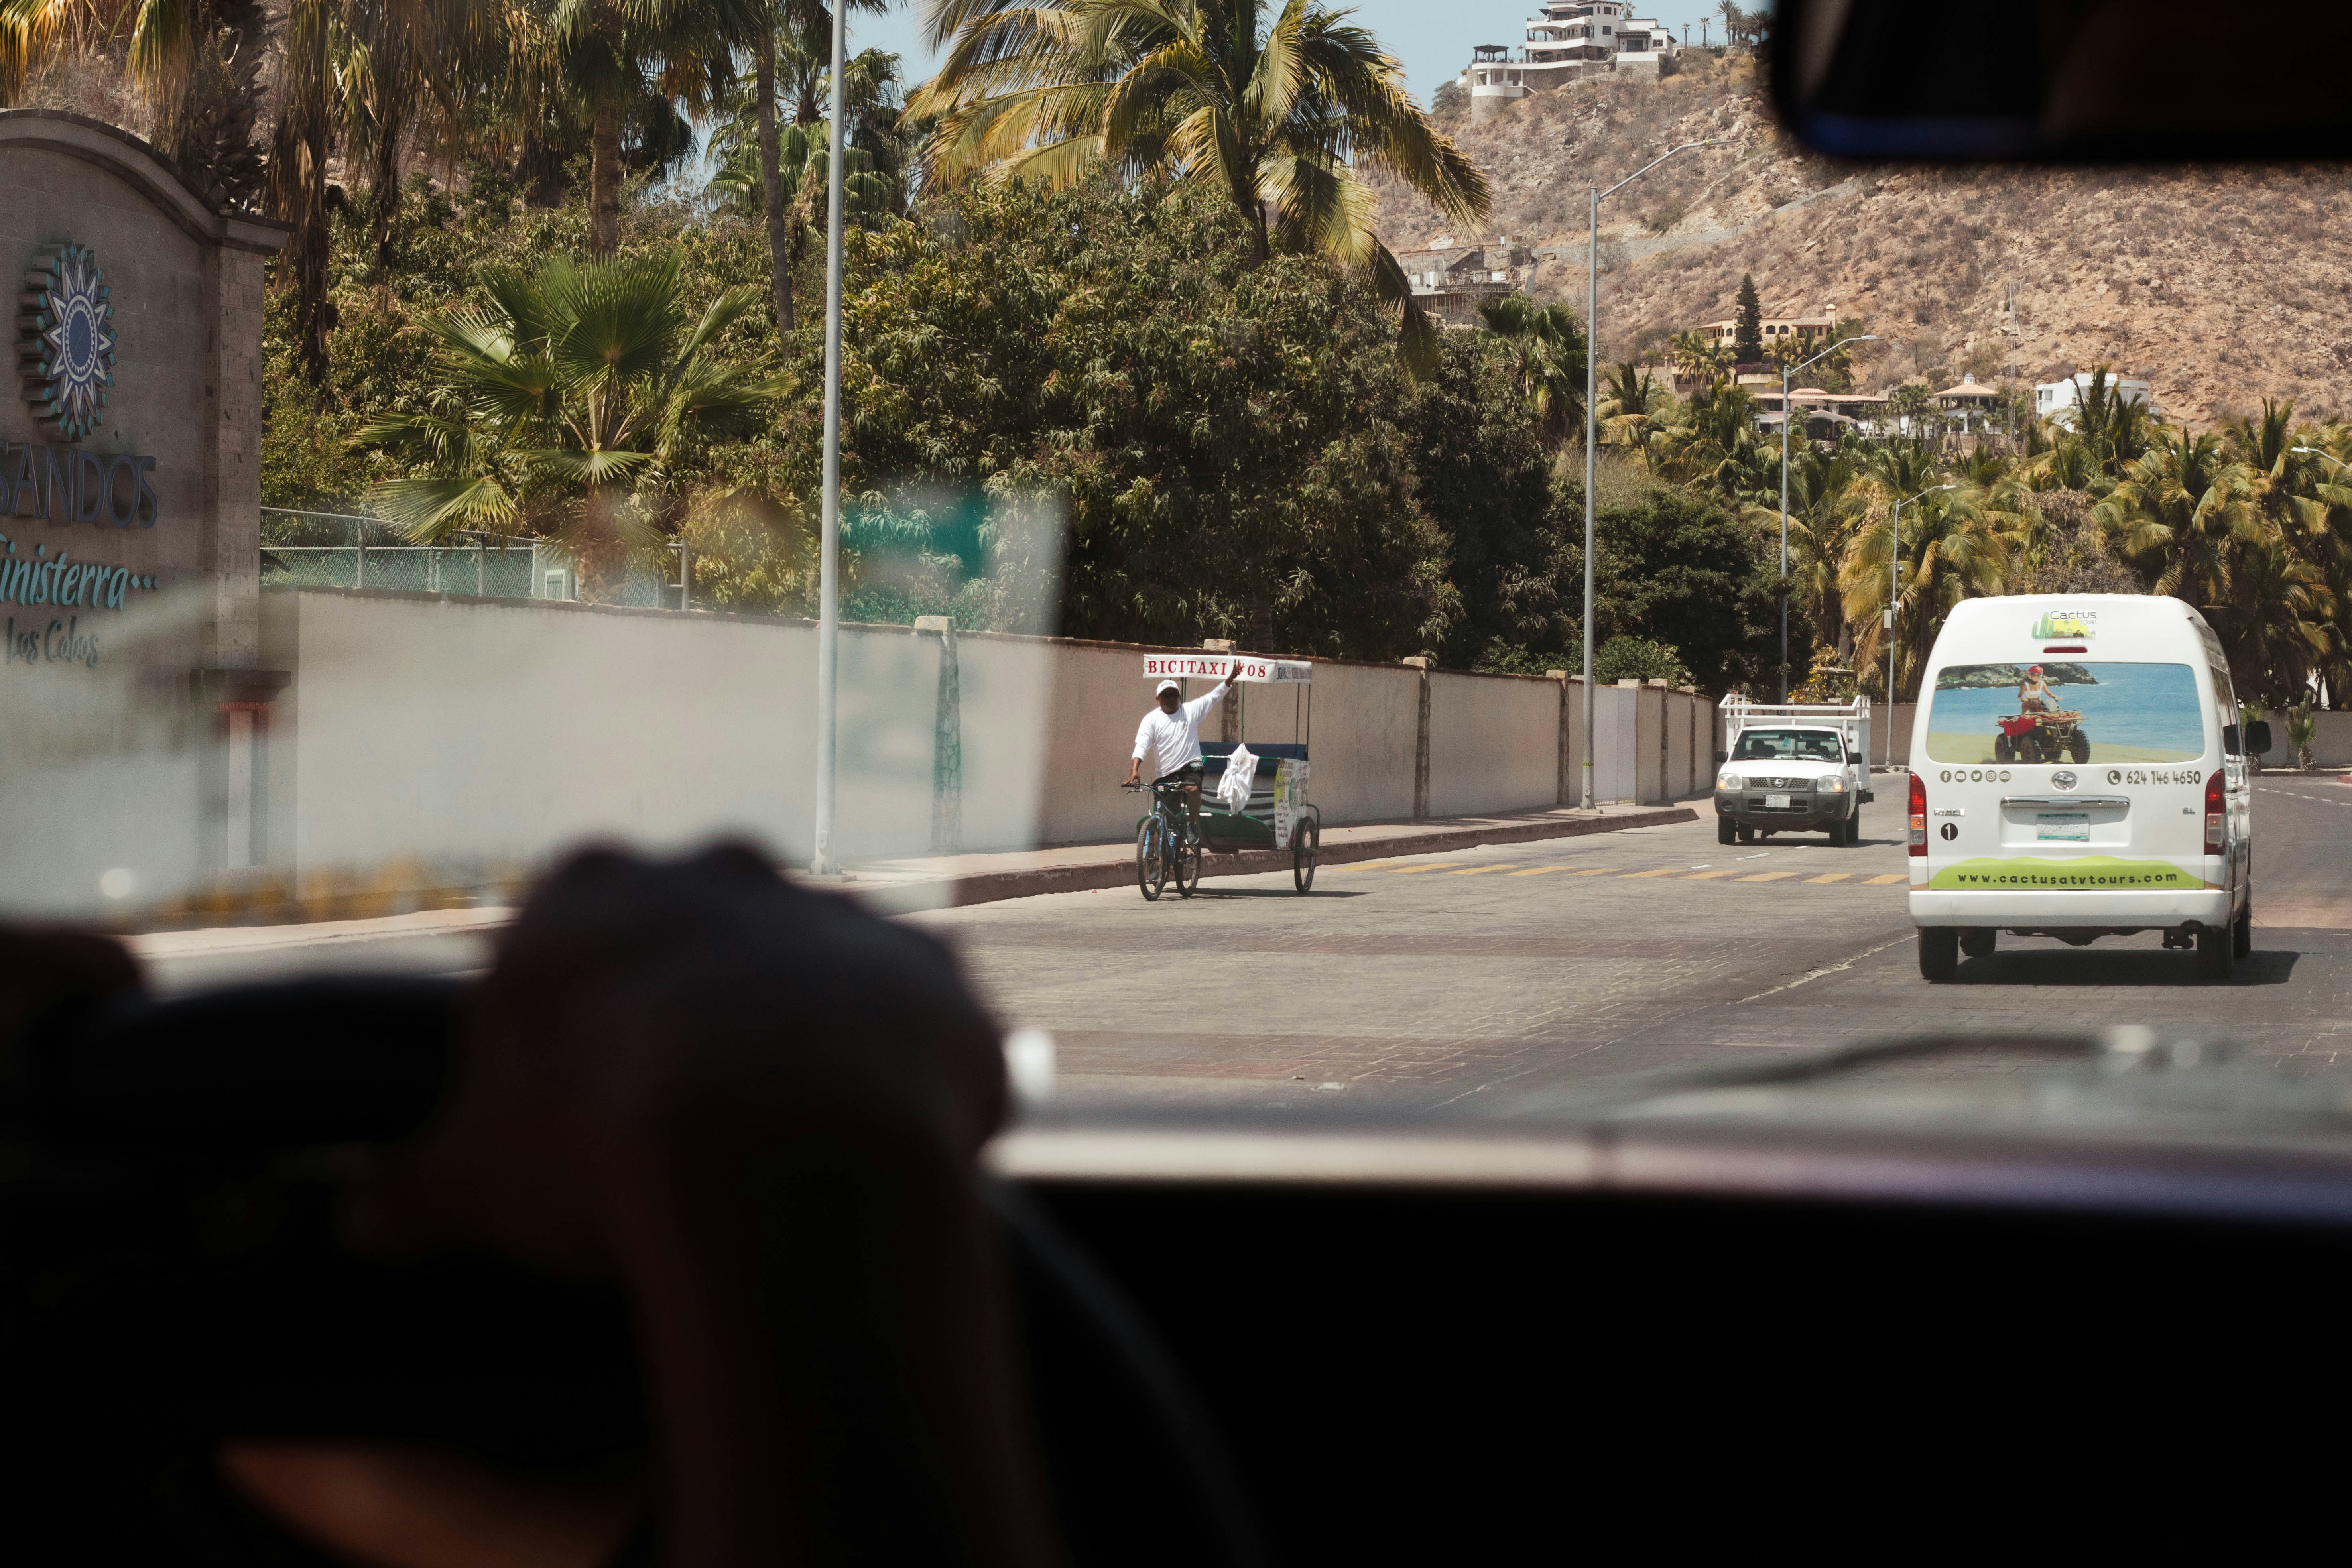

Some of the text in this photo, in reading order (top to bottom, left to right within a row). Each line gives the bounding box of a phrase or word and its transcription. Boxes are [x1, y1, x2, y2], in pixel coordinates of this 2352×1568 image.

[0, 533, 128, 610] inisterra
[2050, 610, 2097, 619] Cactus
[7, 618, 39, 665] Los
[1148, 660, 1226, 675] BICITAXI
[2127, 770, 2201, 785] 624 146 4650
[1945, 824, 1951, 840] 1
[1958, 873, 2177, 885] www.cactusatvtours.com
